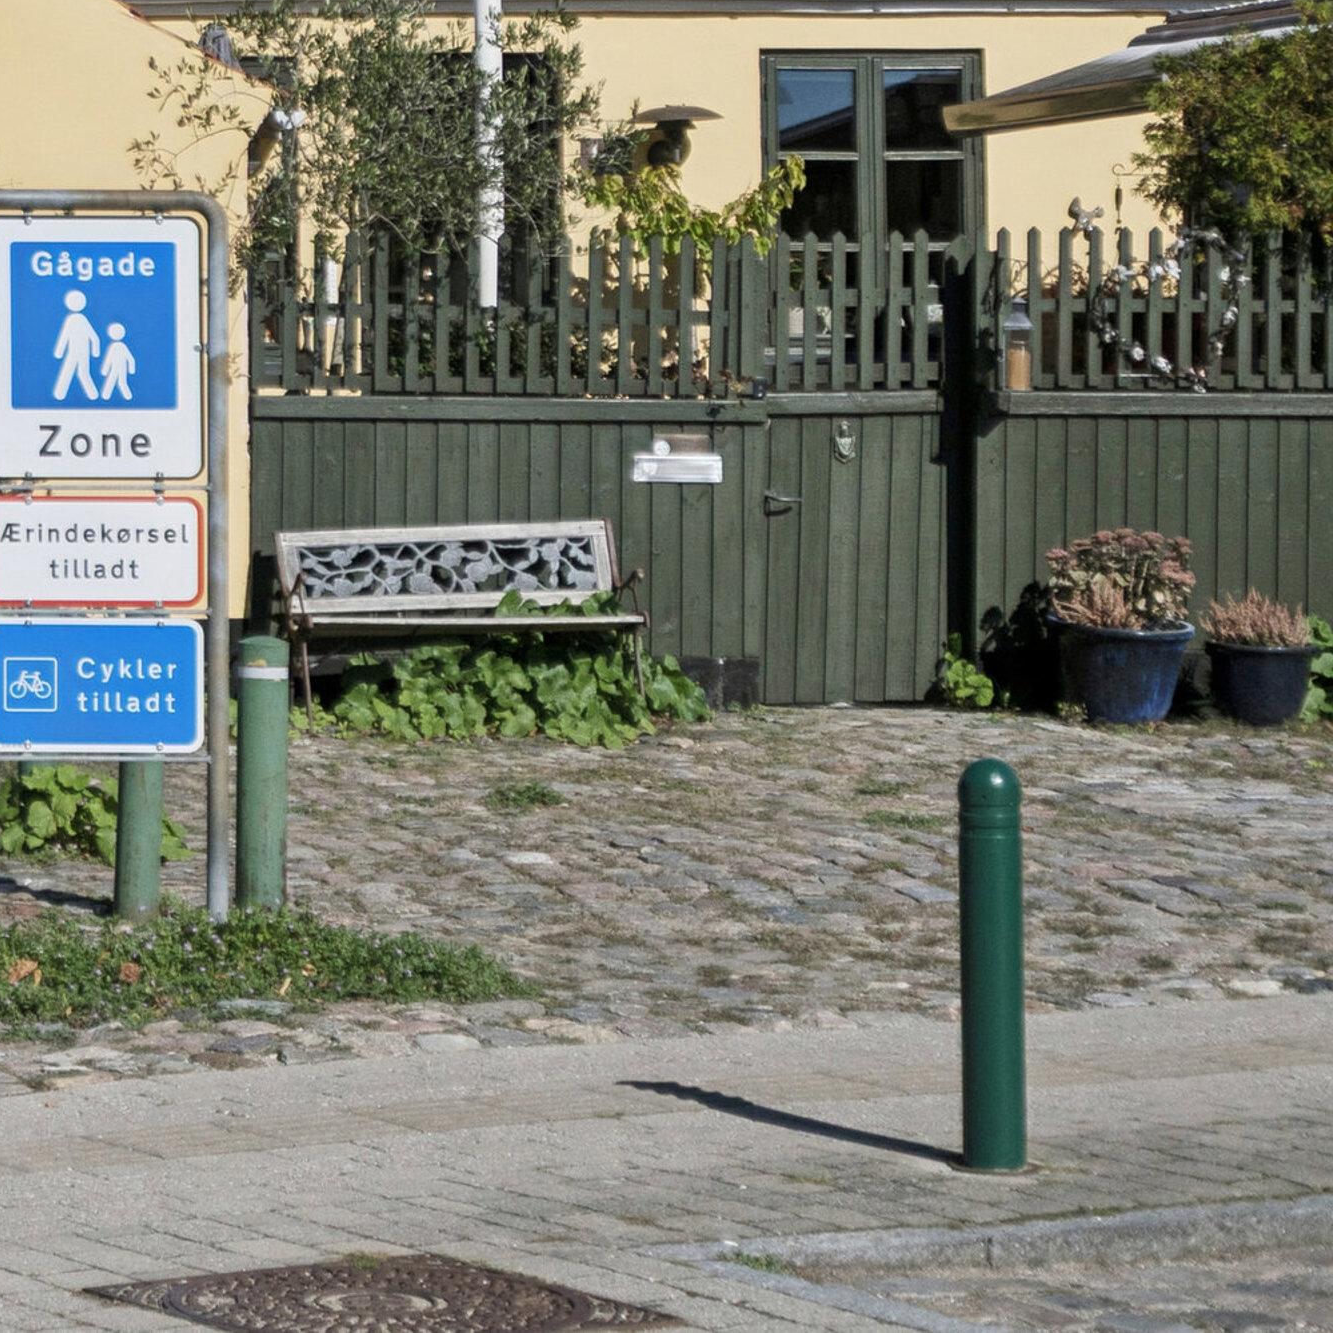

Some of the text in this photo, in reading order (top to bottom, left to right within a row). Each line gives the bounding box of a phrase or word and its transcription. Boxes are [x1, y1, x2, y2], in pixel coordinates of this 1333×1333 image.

[30, 250, 156, 282] Gågade
[37, 423, 152, 459] Zone
[48, 557, 140, 580] tilladt
[76, 656, 178, 684] Cykler
[76, 690, 177, 714] tilladt
